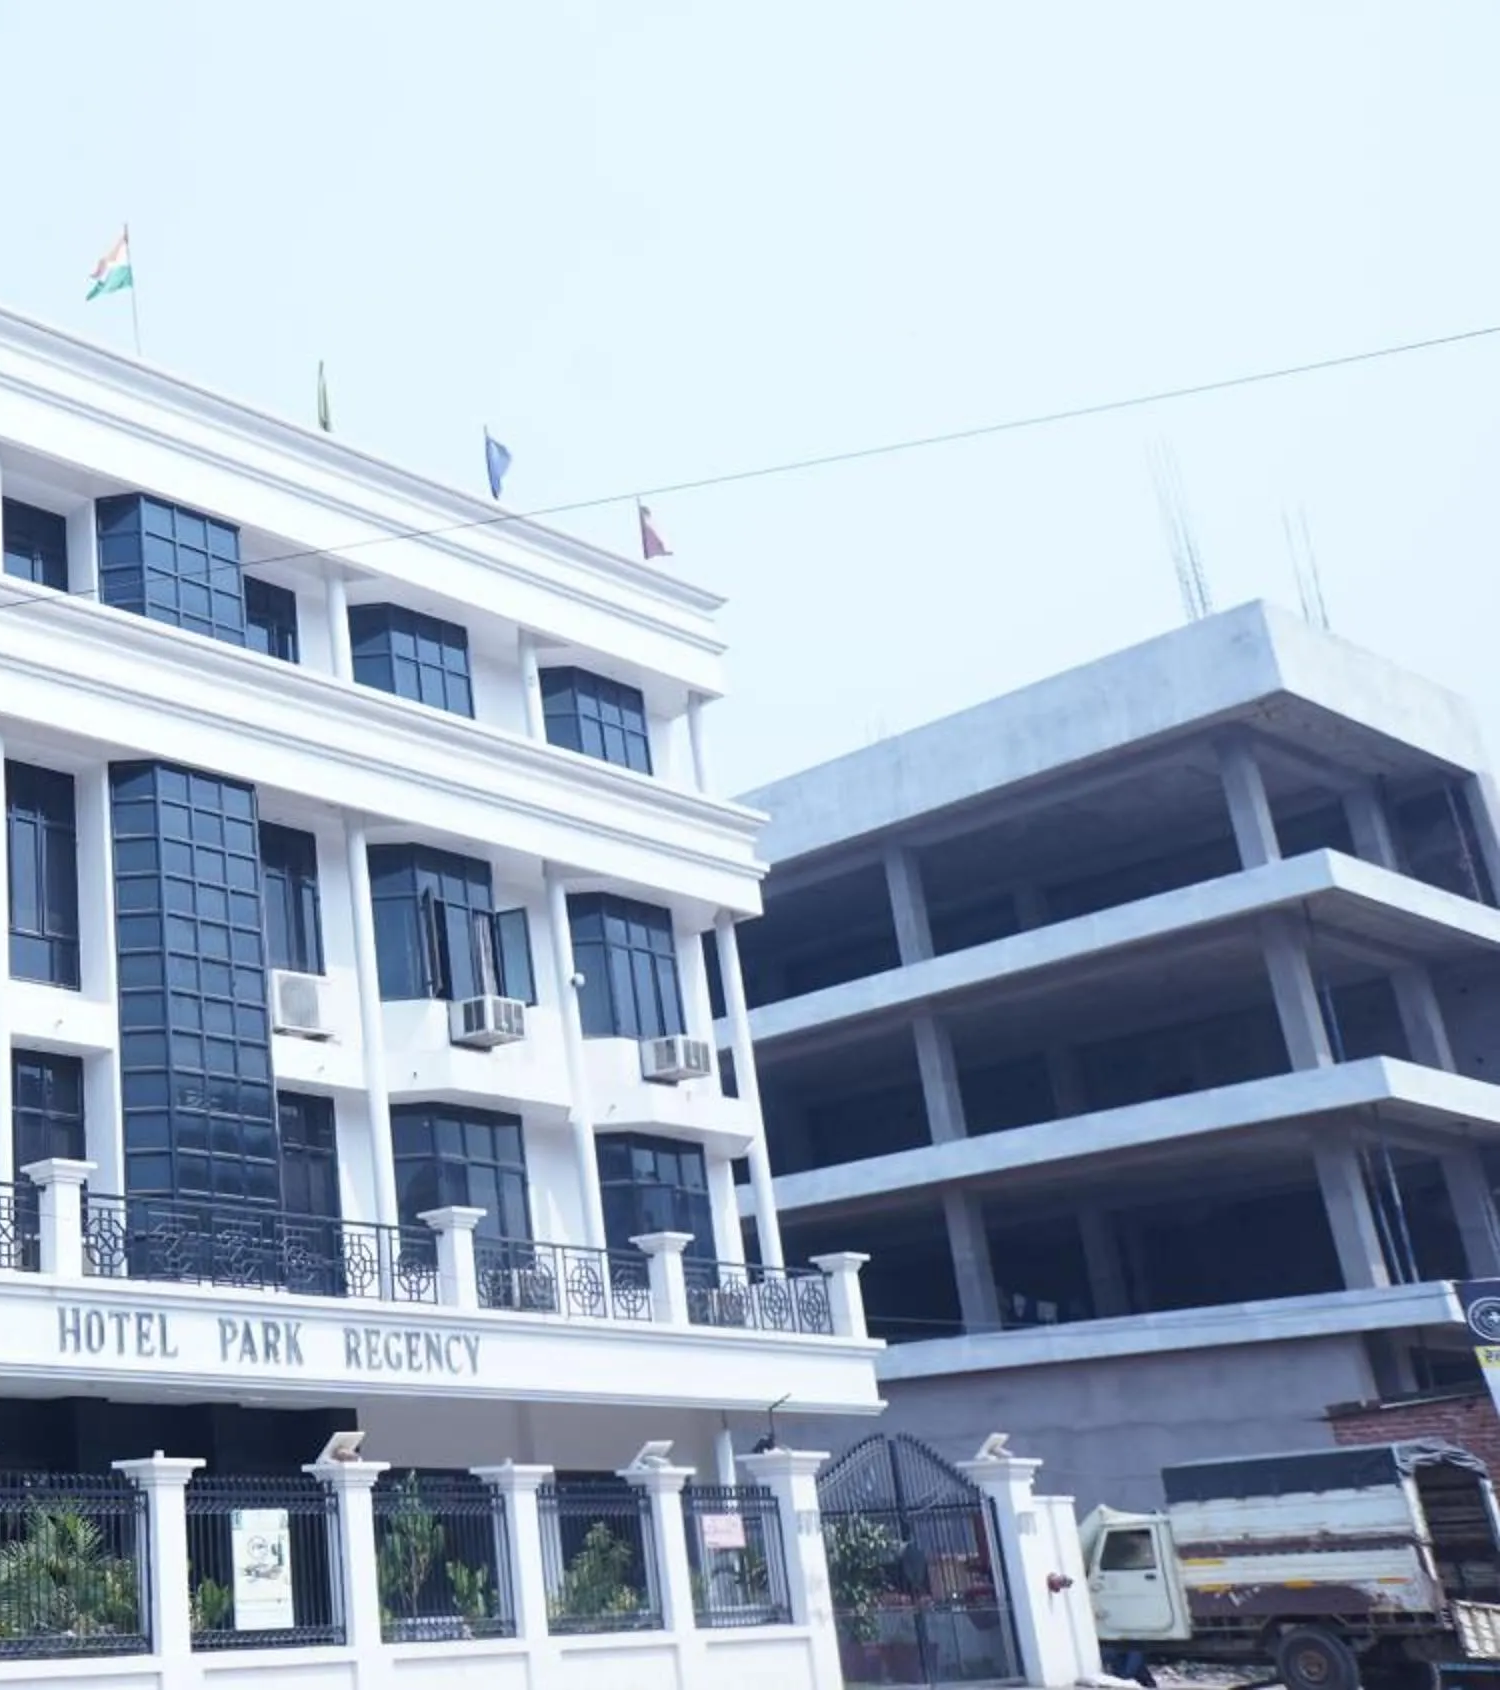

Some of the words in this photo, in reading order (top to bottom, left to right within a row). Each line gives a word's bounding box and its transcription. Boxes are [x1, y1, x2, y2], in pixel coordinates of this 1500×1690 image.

[57, 1305, 179, 1359] HOTEL
[217, 1317, 305, 1365] PARK
[343, 1326, 481, 1375] REGENCY
